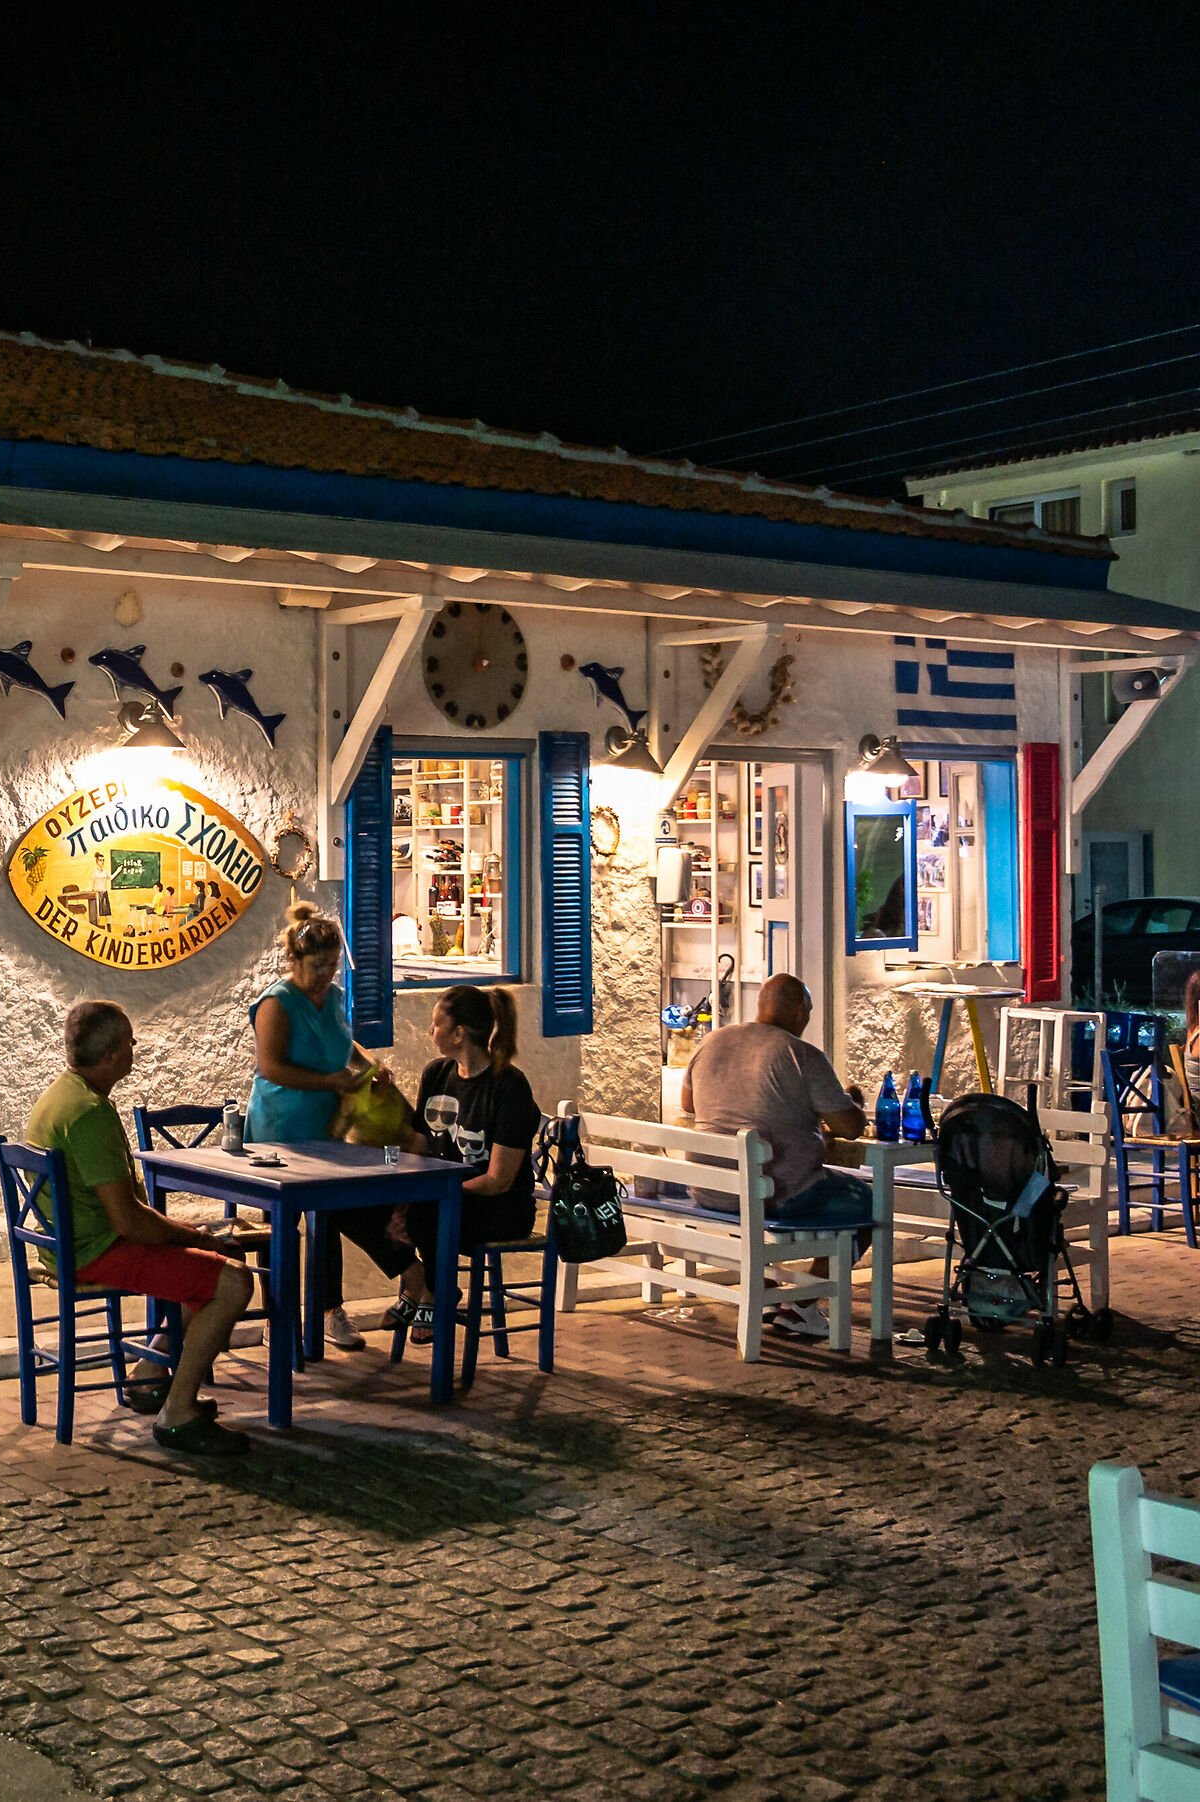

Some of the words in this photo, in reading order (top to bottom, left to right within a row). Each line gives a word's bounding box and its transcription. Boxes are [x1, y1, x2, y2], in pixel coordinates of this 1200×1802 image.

[175, 802, 264, 895] ΣΧΟΛΕΙΟ
[35, 895, 79, 942] DER
[85, 897, 238, 966] KINDERGARDEN
